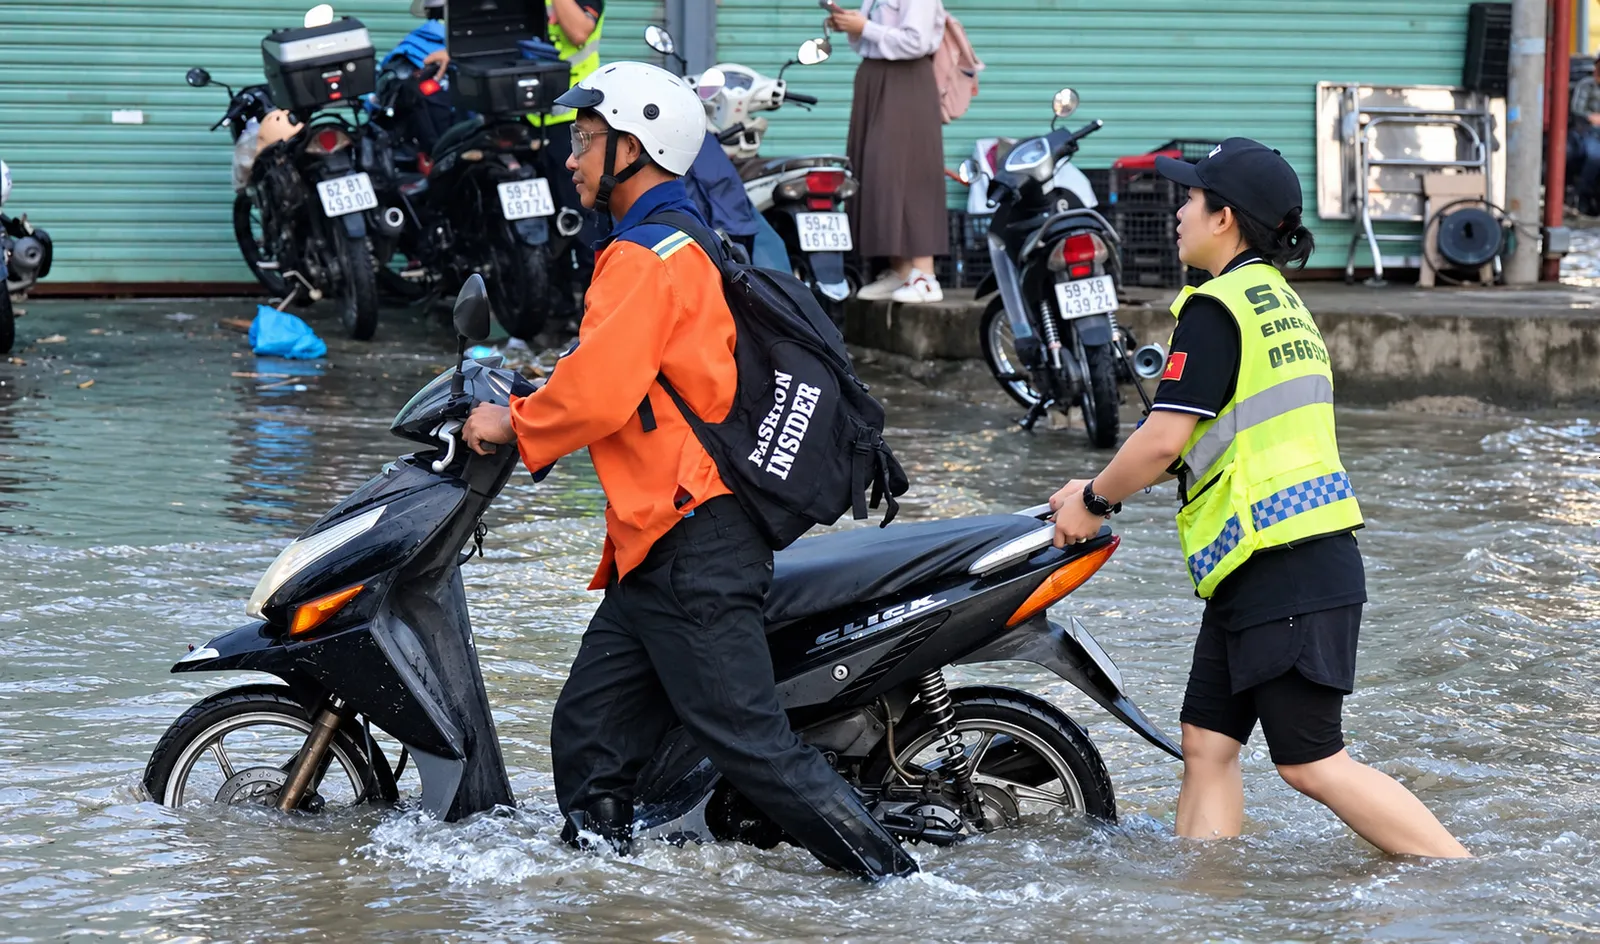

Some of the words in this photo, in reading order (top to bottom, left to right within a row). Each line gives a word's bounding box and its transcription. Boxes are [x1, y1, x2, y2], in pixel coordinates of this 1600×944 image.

[747, 369, 793, 467] FASHION
[765, 382, 822, 480] INSIDER
[815, 594, 935, 645] CLICK
